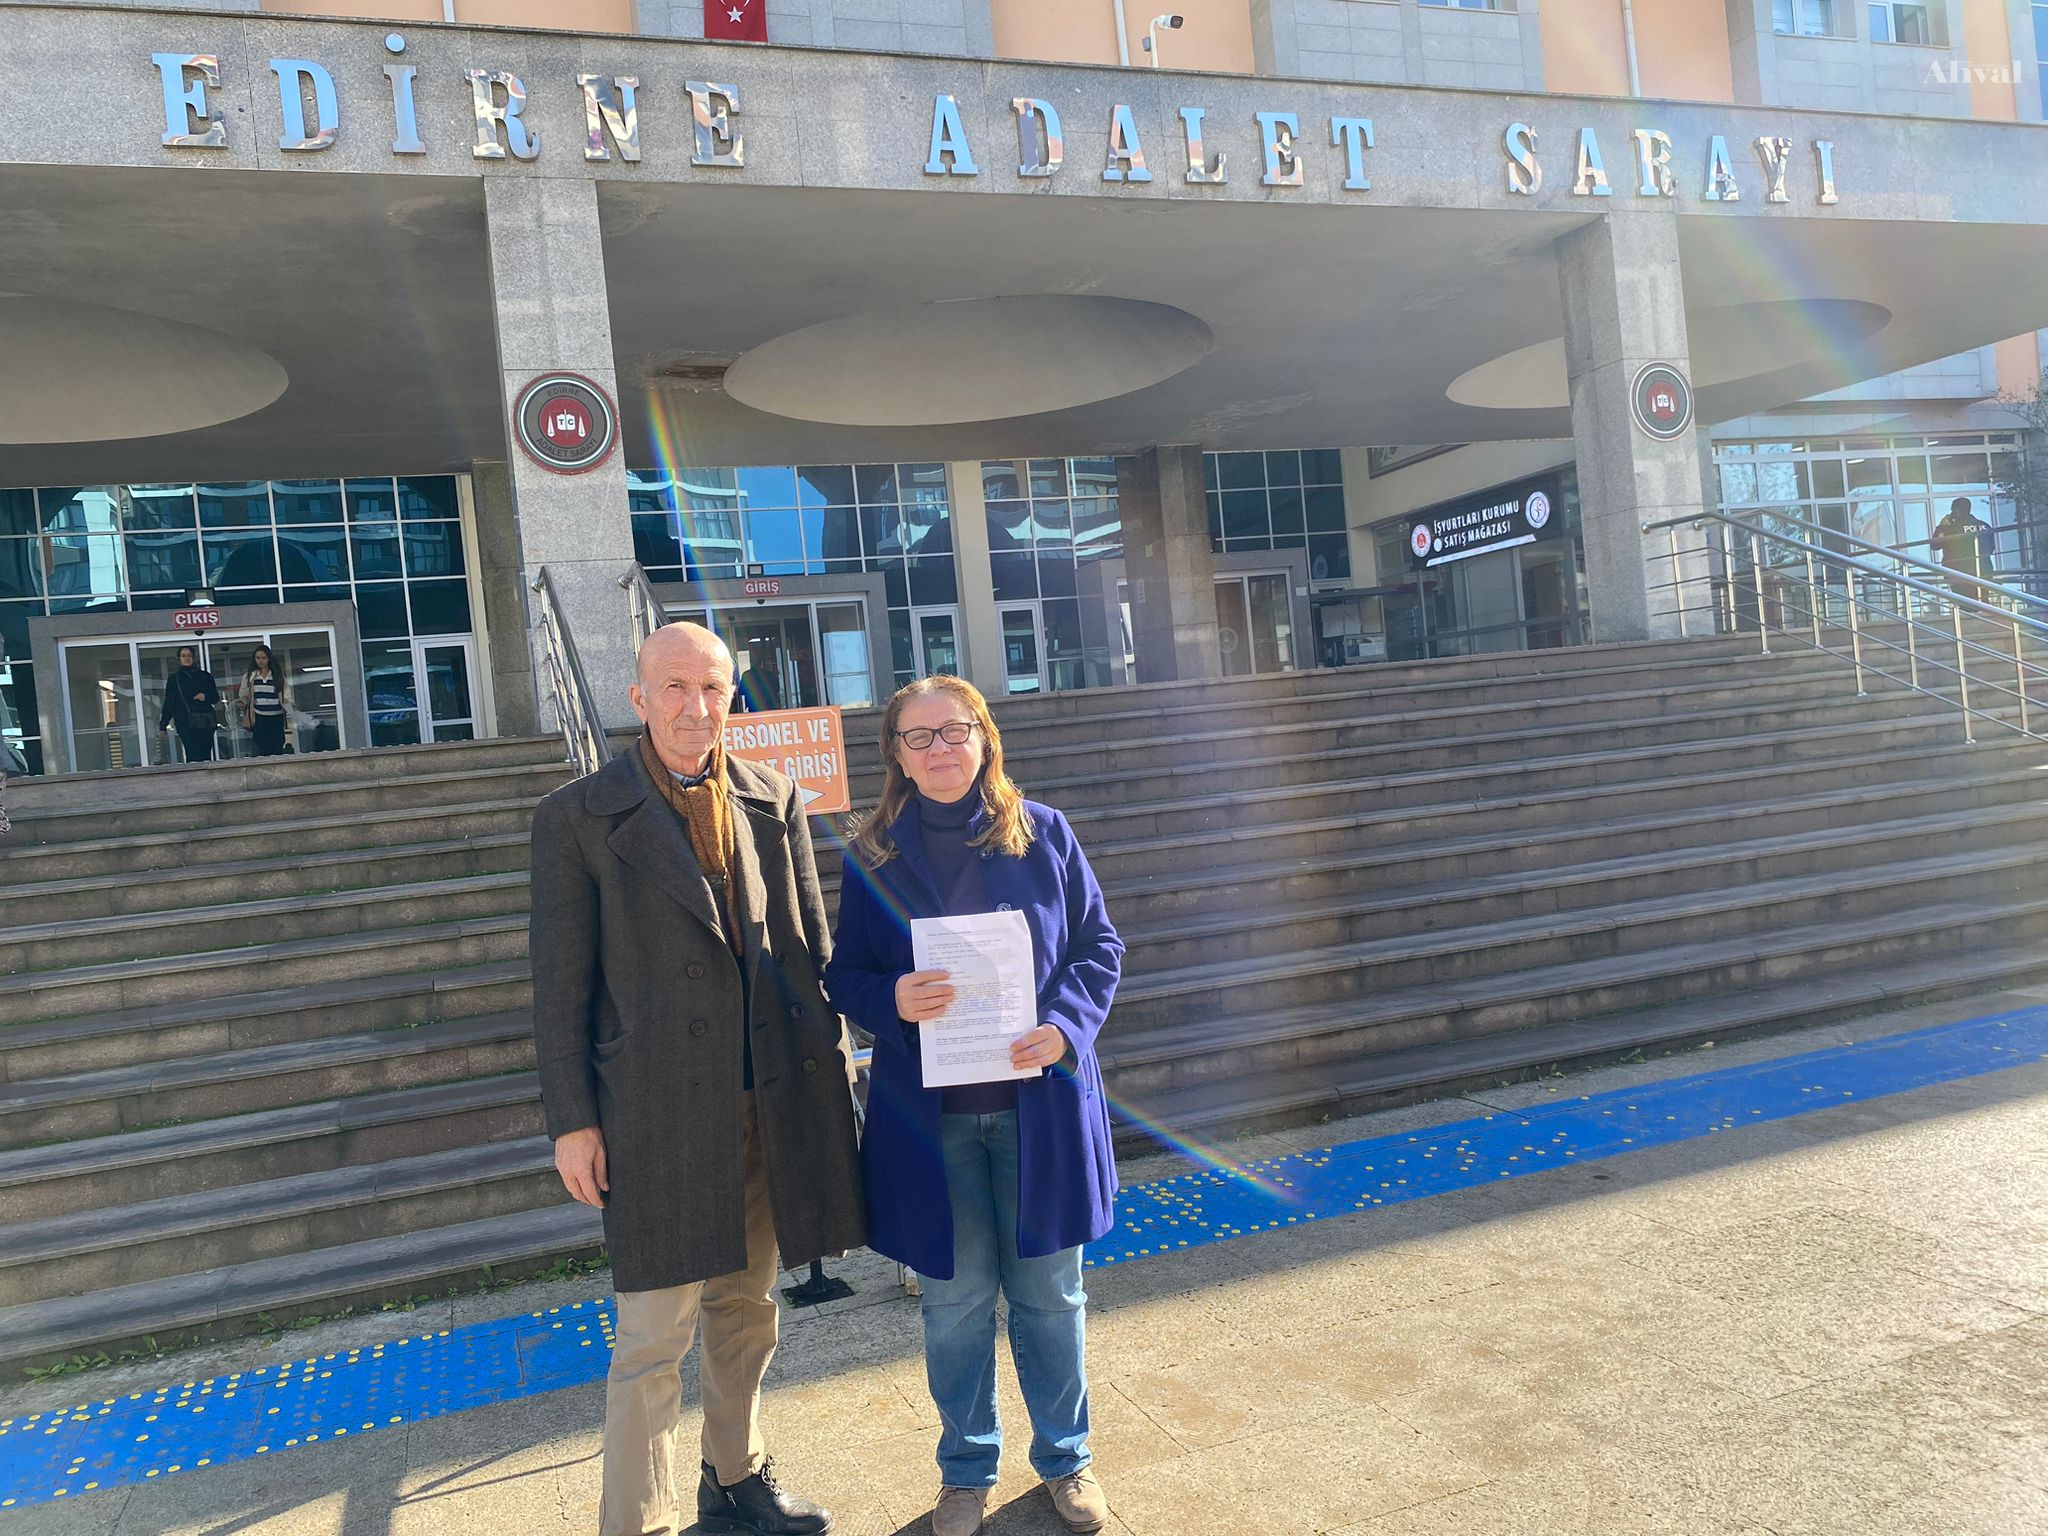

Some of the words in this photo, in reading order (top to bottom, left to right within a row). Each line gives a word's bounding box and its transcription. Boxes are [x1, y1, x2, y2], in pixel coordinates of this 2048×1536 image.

[152, 33, 745, 168] EDİRNE
[924, 94, 1373, 191] ADALET
[1502, 121, 1839, 205] SARAYI
[537, 438, 569, 458] ADALET
[1433, 511, 1481, 536] İŞYURTLARI
[1481, 500, 1520, 522] KURUMU
[1444, 530, 1467, 548] SATIŞ
[1467, 520, 1511, 543] MAĞAZASI
[745, 580, 779, 594] GİRİŞ
[175, 611, 219, 627] ÇIKIŞ
[723, 720, 804, 750] ERSONEL
[807, 718, 831, 743] VE
[784, 747, 838, 783] GİRİŞİ
